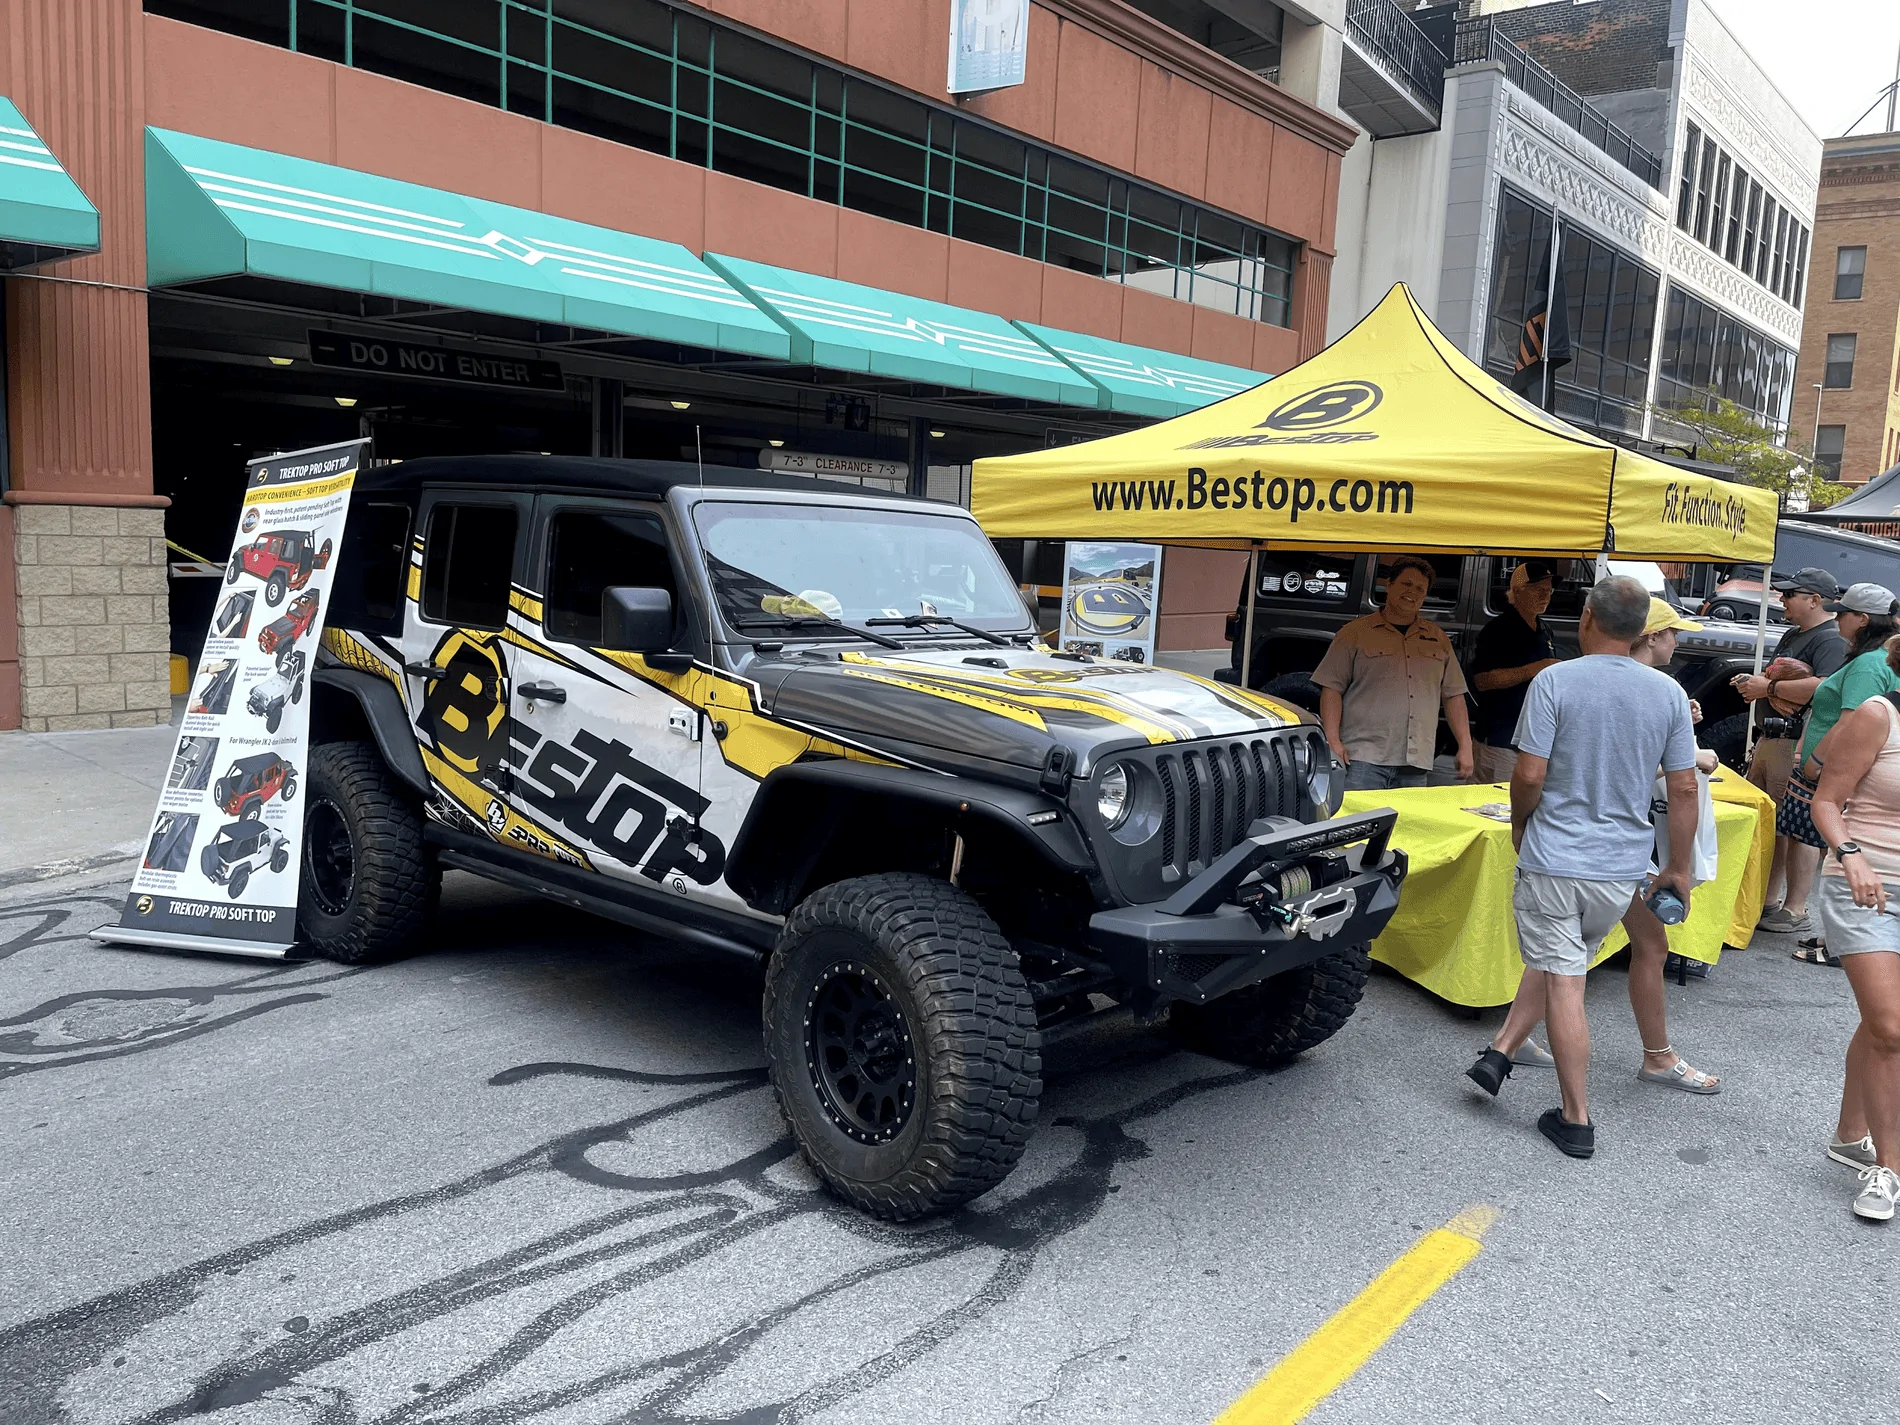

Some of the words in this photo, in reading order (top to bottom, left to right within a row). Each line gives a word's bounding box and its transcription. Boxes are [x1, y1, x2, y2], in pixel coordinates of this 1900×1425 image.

[350, 342, 388, 366] DO
[399, 348, 447, 373] NOT
[457, 355, 531, 382] ENTER
[280, 465, 309, 480] TREKTOP
[309, 462, 323, 476] PRO
[323, 459, 339, 473] SOFT
[339, 456, 350, 470] TOP
[815, 457, 873, 473] CLEARANCE
[267, 489, 302, 500] CONVENIENCE
[306, 486, 318, 495] SOFT
[319, 484, 328, 493] TOP
[1091, 467, 1415, 523] www.Bestop.com
[1661, 481, 1679, 524] Fit.
[1680, 486, 1723, 529] Function.
[1724, 495, 1746, 542] Style.
[229, 736, 238, 744] For
[239, 737, 261, 747] Wrangler
[168, 900, 210, 918] TREKTOP
[210, 906, 228, 919] PRO
[228, 906, 254, 922] SOFT
[255, 909, 276, 923] TOP
